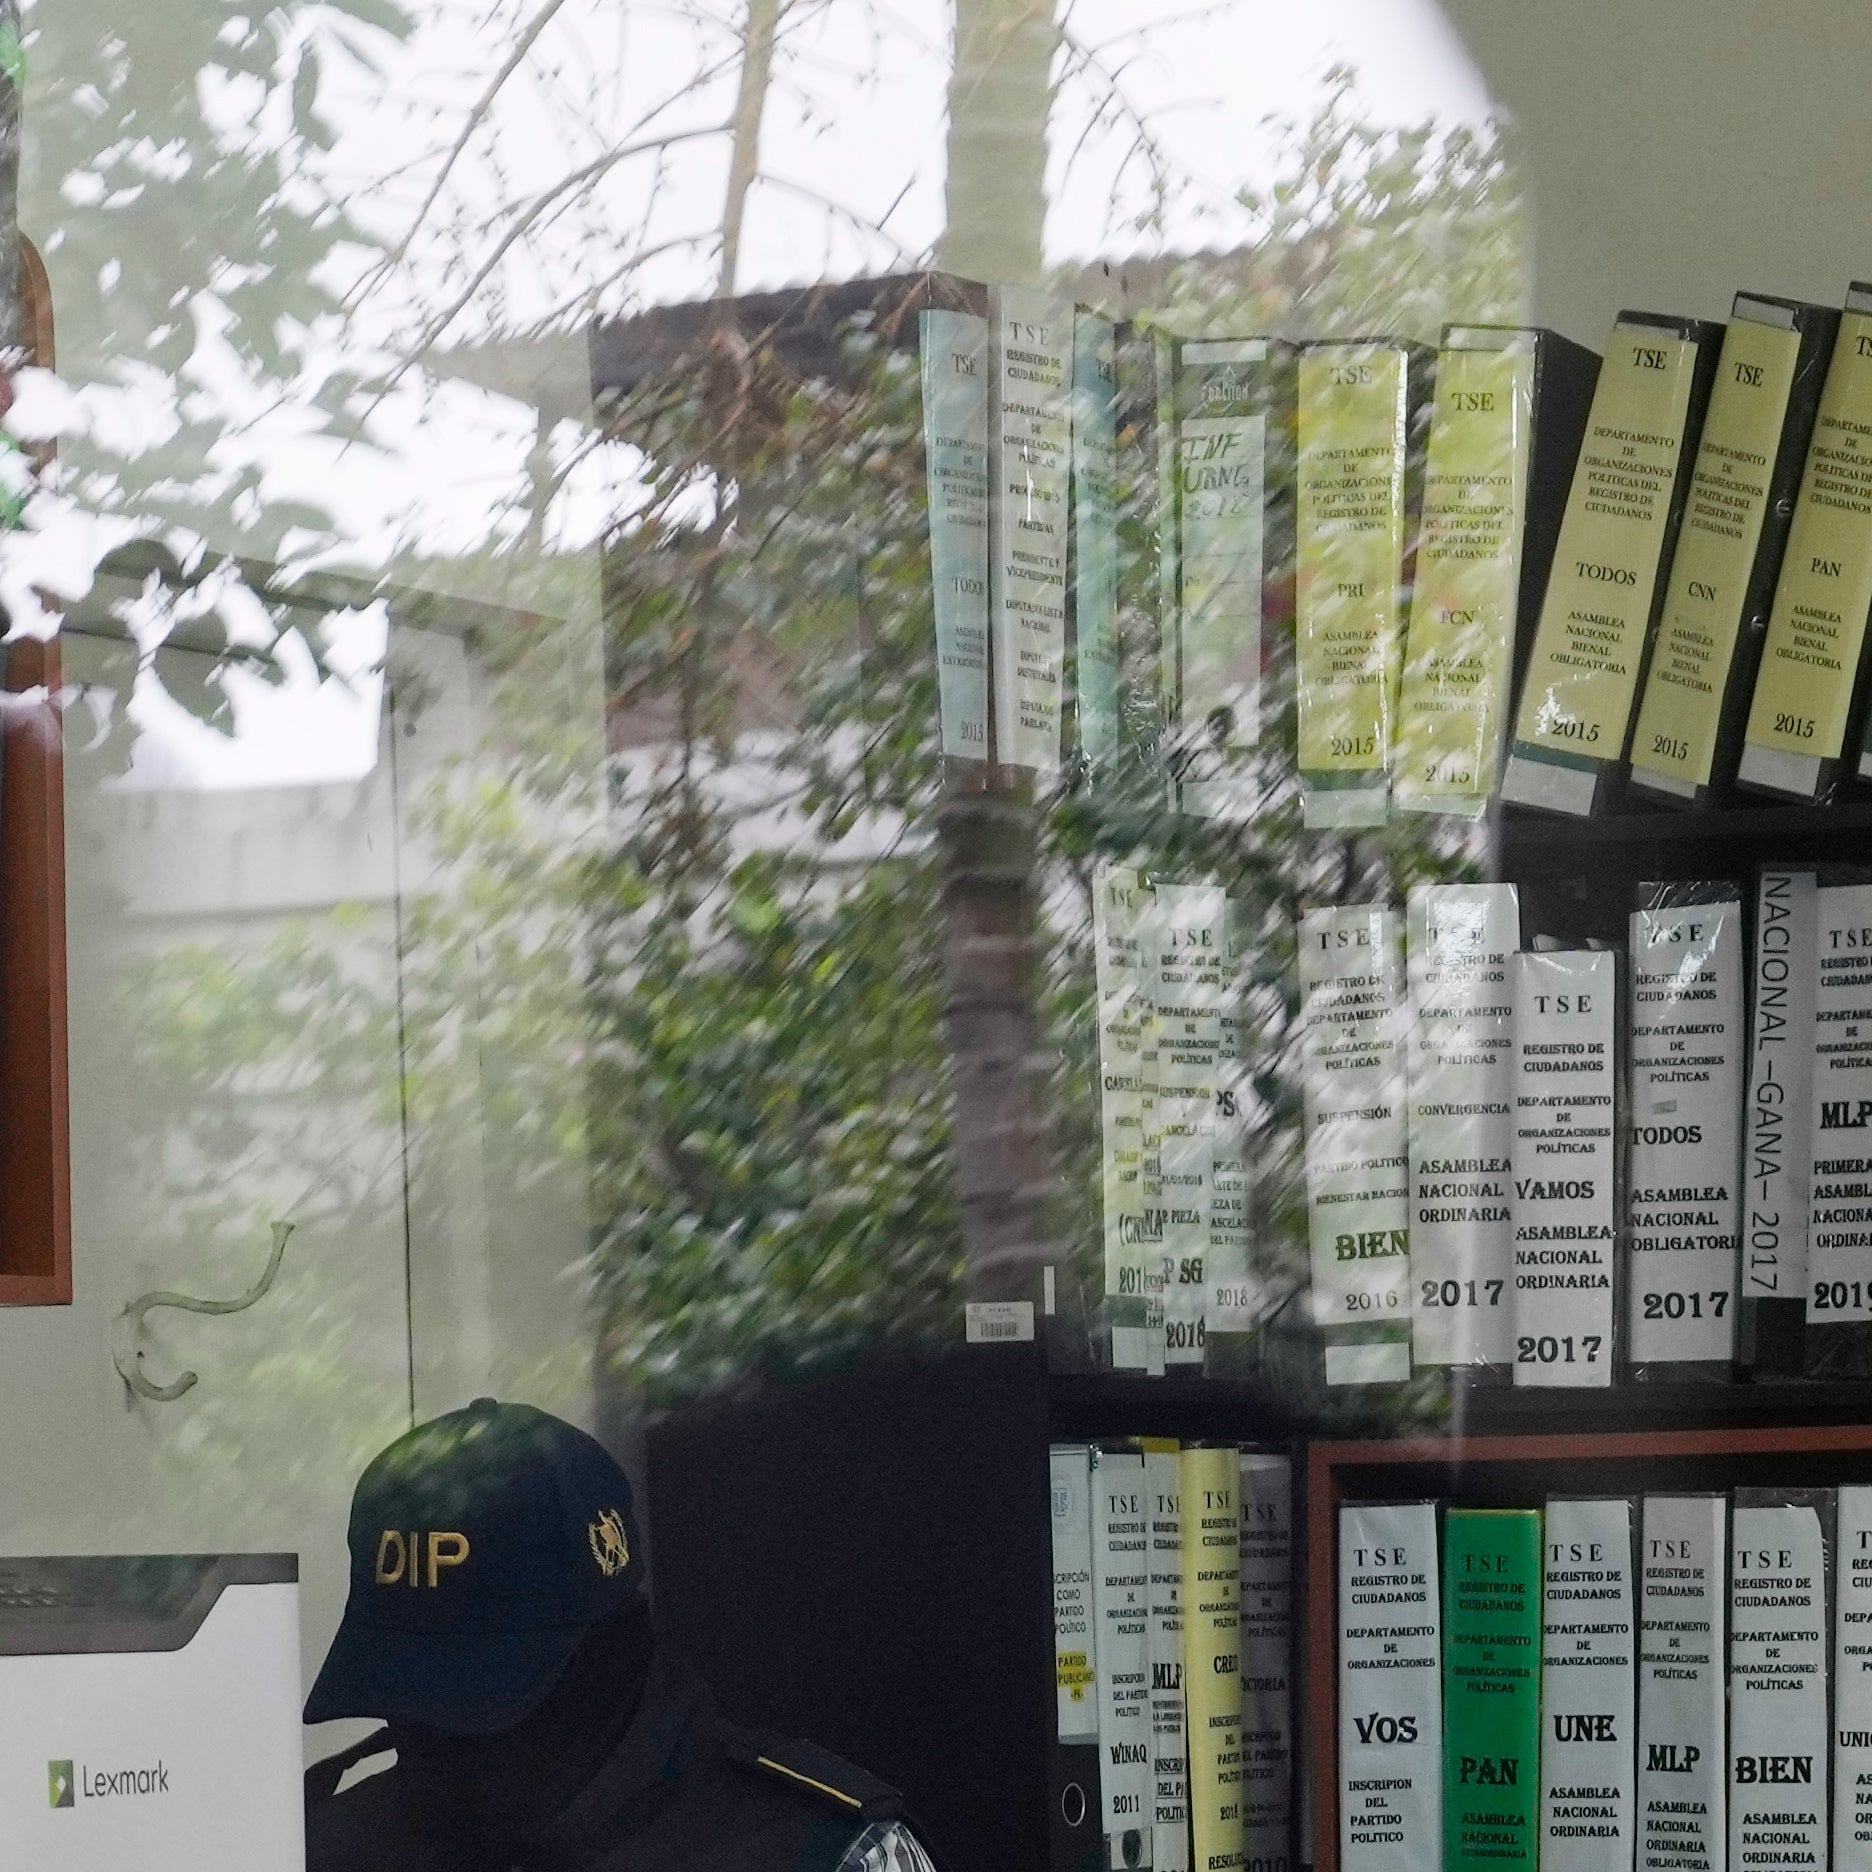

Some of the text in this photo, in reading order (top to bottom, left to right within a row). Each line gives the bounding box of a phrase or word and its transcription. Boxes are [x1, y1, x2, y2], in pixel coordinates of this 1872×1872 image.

[1734, 363, 1764, 388] TSE
[1451, 391, 1495, 412] TSE
[1576, 563, 1637, 587] TODOS
[1810, 557, 1842, 579] PAN
[1338, 582, 1364, 598] PRI
[1687, 581, 1716, 602] CNN
[1567, 608, 1627, 631] ASAMBLEA
[1565, 625, 1623, 645] NACIONAL
[1571, 640, 1611, 657] BIENAL
[1550, 654, 1627, 677] OBLIGATORIA
[1330, 735, 1375, 757] 2015
[1652, 735, 1688, 761] 2015
[1757, 876, 1792, 1051] NACIONAL
[1417, 1102, 1511, 1117] CONVERGENCIA
[1631, 1125, 1703, 1146] TODOS
[1515, 1180, 1595, 1200] VAMOS
[1516, 1226, 1611, 1242] ASAMBLEA
[1335, 1230, 1411, 1262] BIEN
[1515, 1250, 1602, 1265] NACIONAL
[1750, 1212, 1780, 1292] 2017
[1421, 1279, 1504, 1307] 2017
[1516, 1273, 1610, 1290] ORDINARIA
[1643, 1291, 1729, 1319] 2017
[376, 1530, 470, 1587] DIP
[1056, 1589, 1080, 1600] COMO
[1353, 1712, 1418, 1744] VOS
[1554, 1715, 1617, 1742] UNE
[1646, 1744, 1700, 1772] MLP
[83, 1760, 169, 1797] Lexmark
[1459, 1757, 1520, 1785] PAN
[1735, 1756, 1813, 1784] BIEN
[1350, 1813, 1402, 1827] PARTIDO
[1550, 1825, 1620, 1838] ORDINARIA
